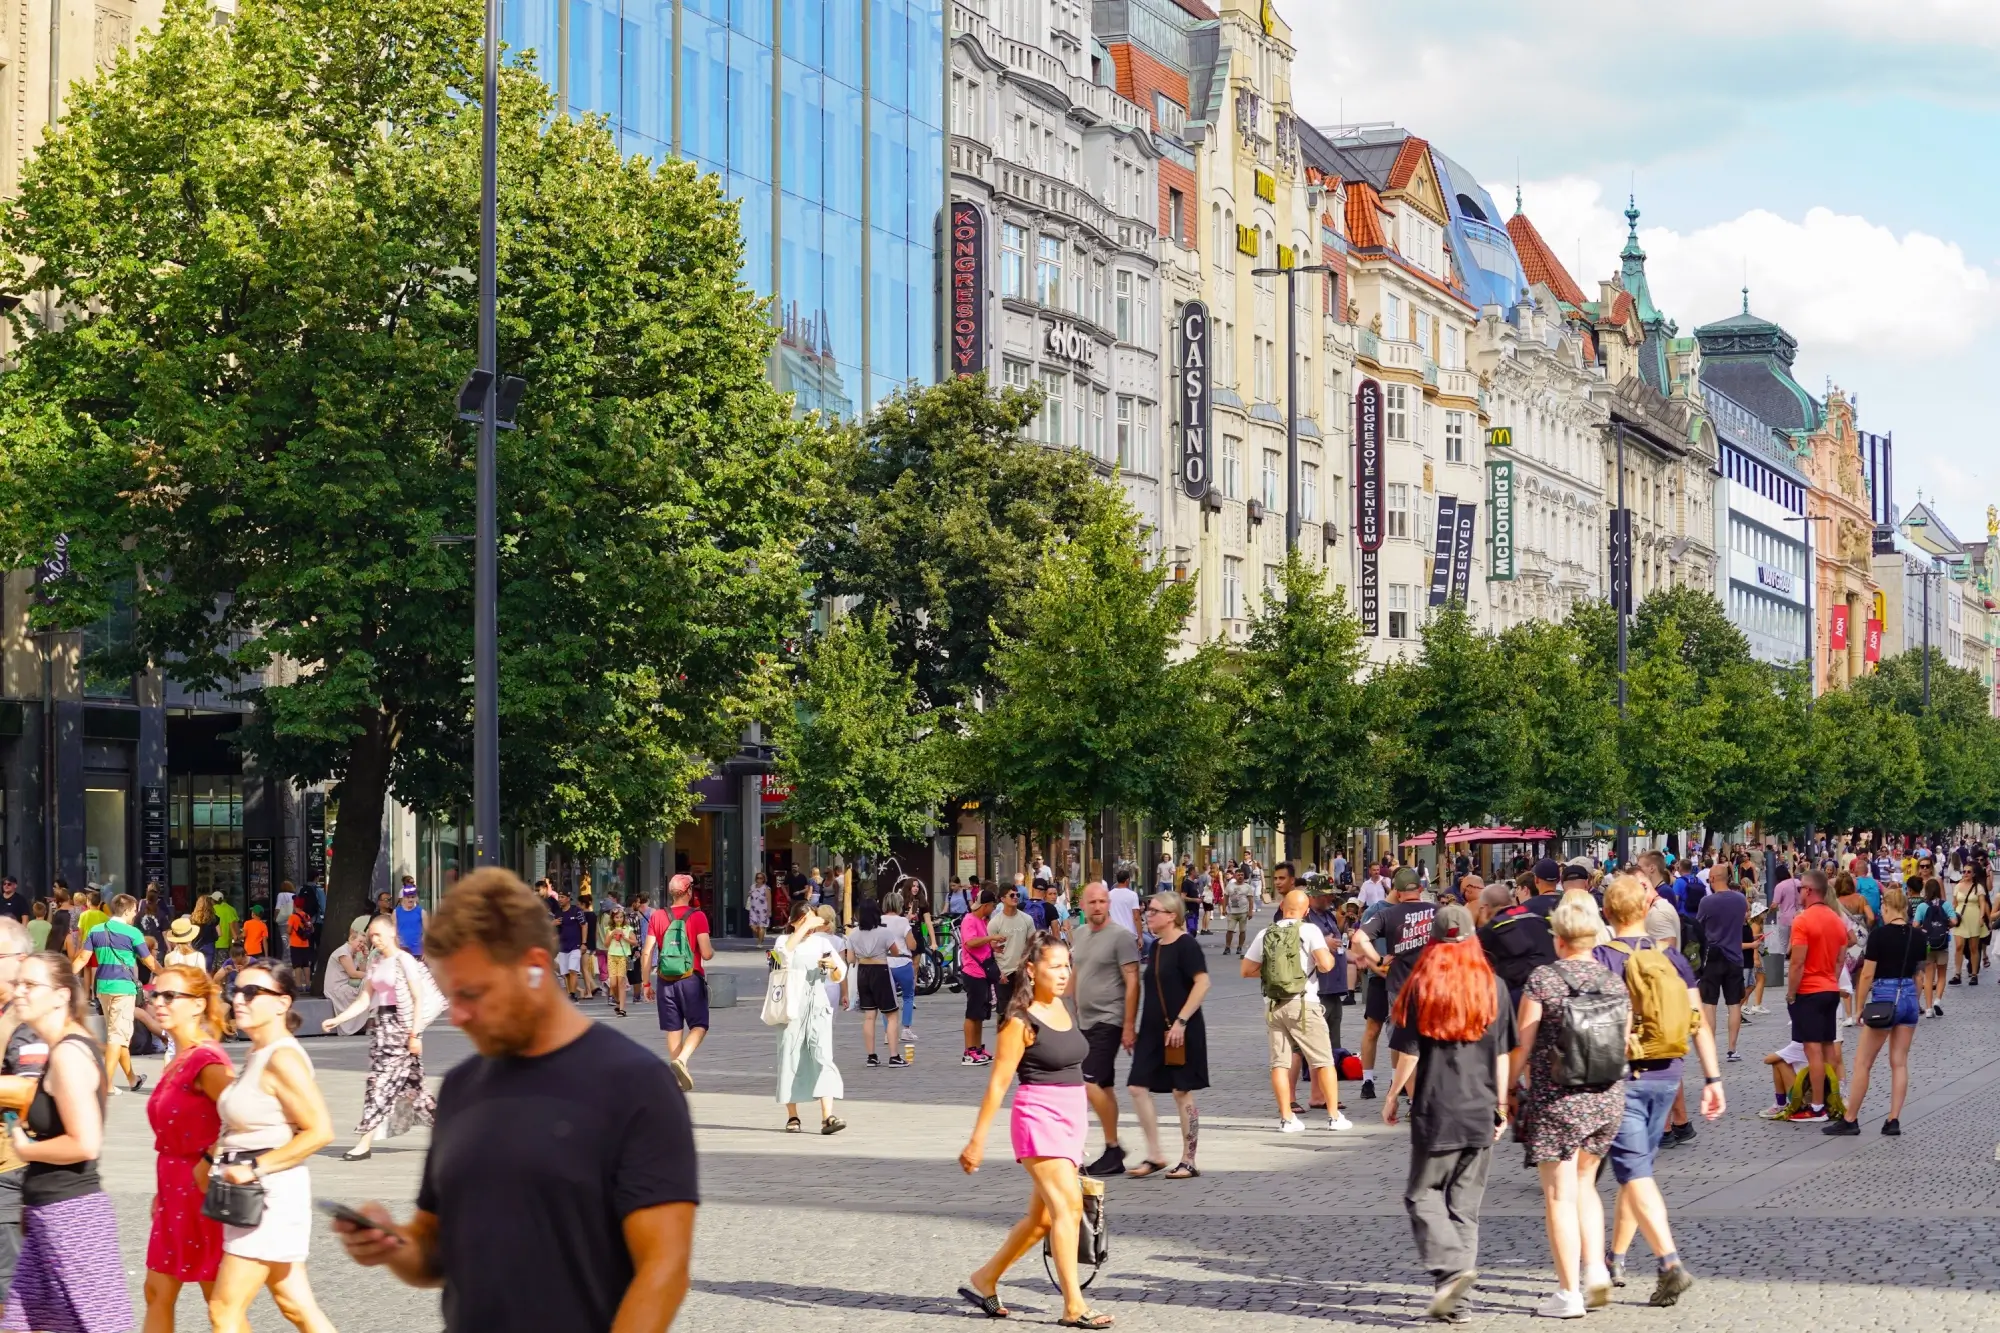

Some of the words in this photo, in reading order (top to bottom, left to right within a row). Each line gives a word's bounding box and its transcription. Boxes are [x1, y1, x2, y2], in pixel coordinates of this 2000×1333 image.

[1185, 314, 1204, 484] CASINO
[1364, 480, 1377, 543] CENTRUM
[1495, 466, 1510, 575] McDonald's
[1432, 508, 1454, 593] MOHITO
[1363, 553, 1376, 633] RESERVE
[1835, 617, 1845, 637] AON
[1869, 630, 1878, 650] AON
[1405, 908, 1435, 927] sport
